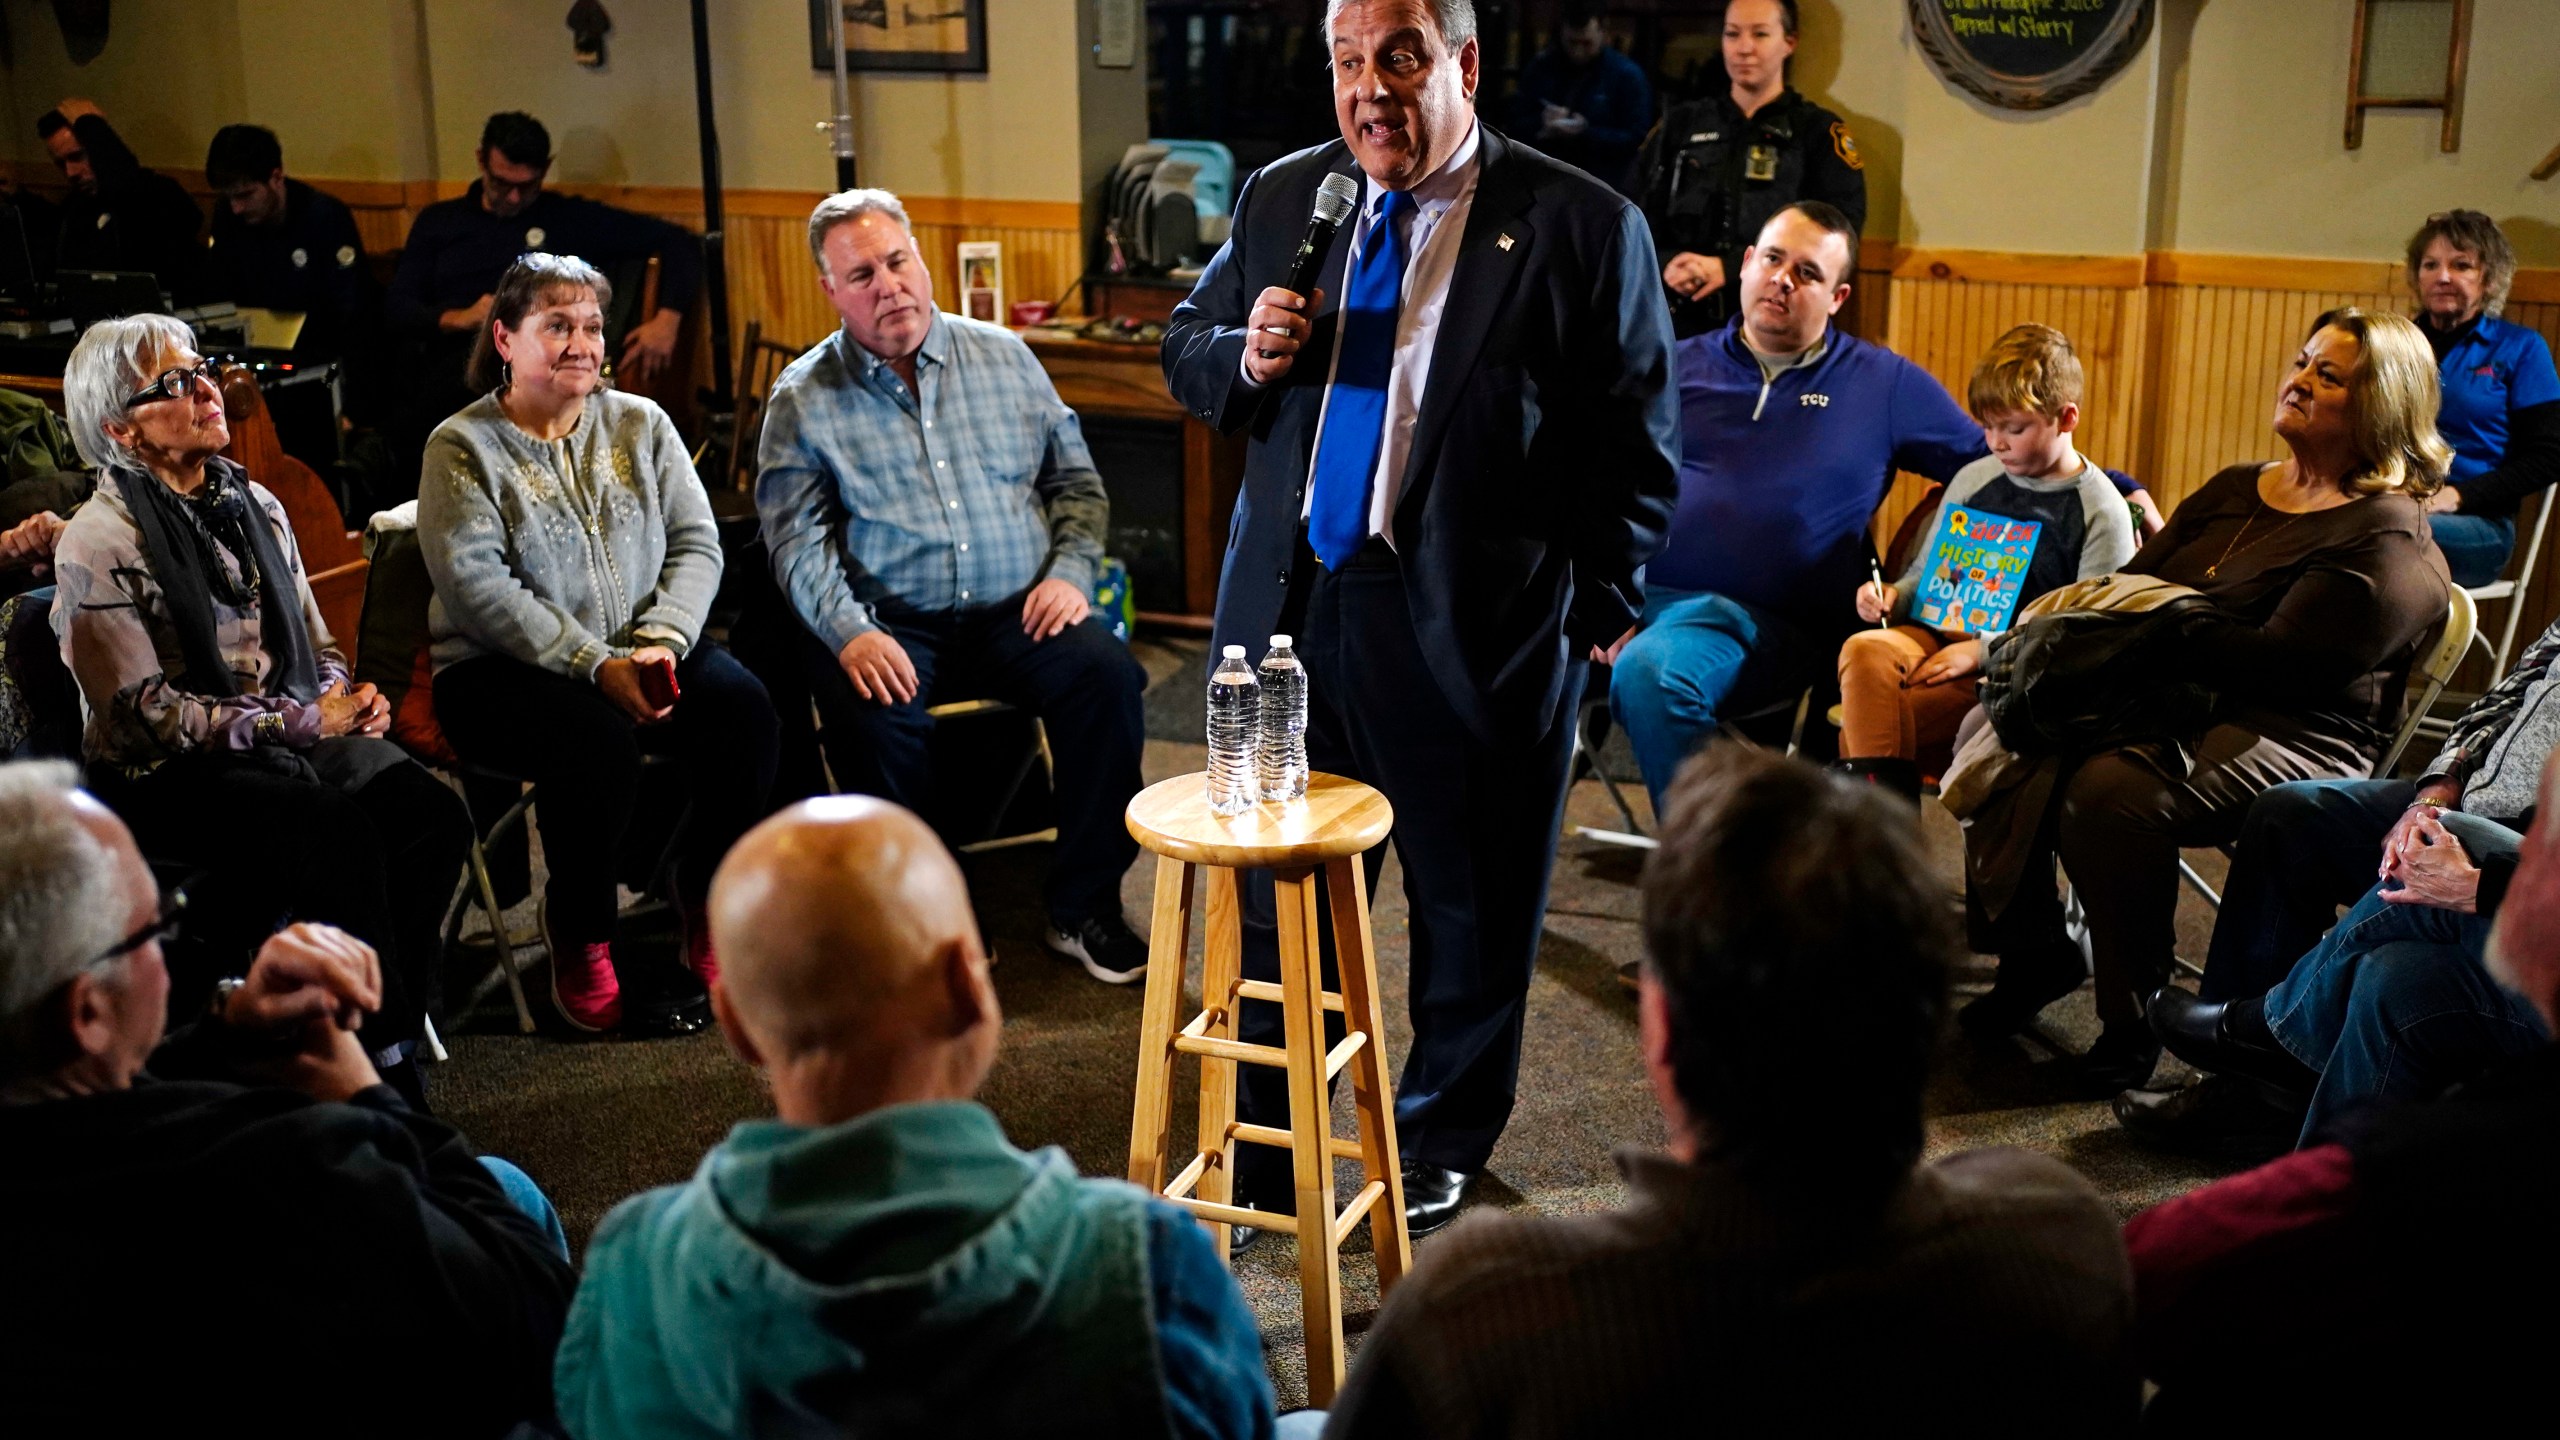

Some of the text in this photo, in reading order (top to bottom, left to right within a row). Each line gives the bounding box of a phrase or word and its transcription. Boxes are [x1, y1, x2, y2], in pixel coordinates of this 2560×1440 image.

[2019, 15, 2074, 46] Starry
[1800, 393, 1829, 407] TCU
[1970, 521, 2036, 544] QUICK
[1938, 541, 2027, 573] HISTORY
[1971, 569, 1984, 580] OF
[1928, 576, 2013, 609] POLITICS
